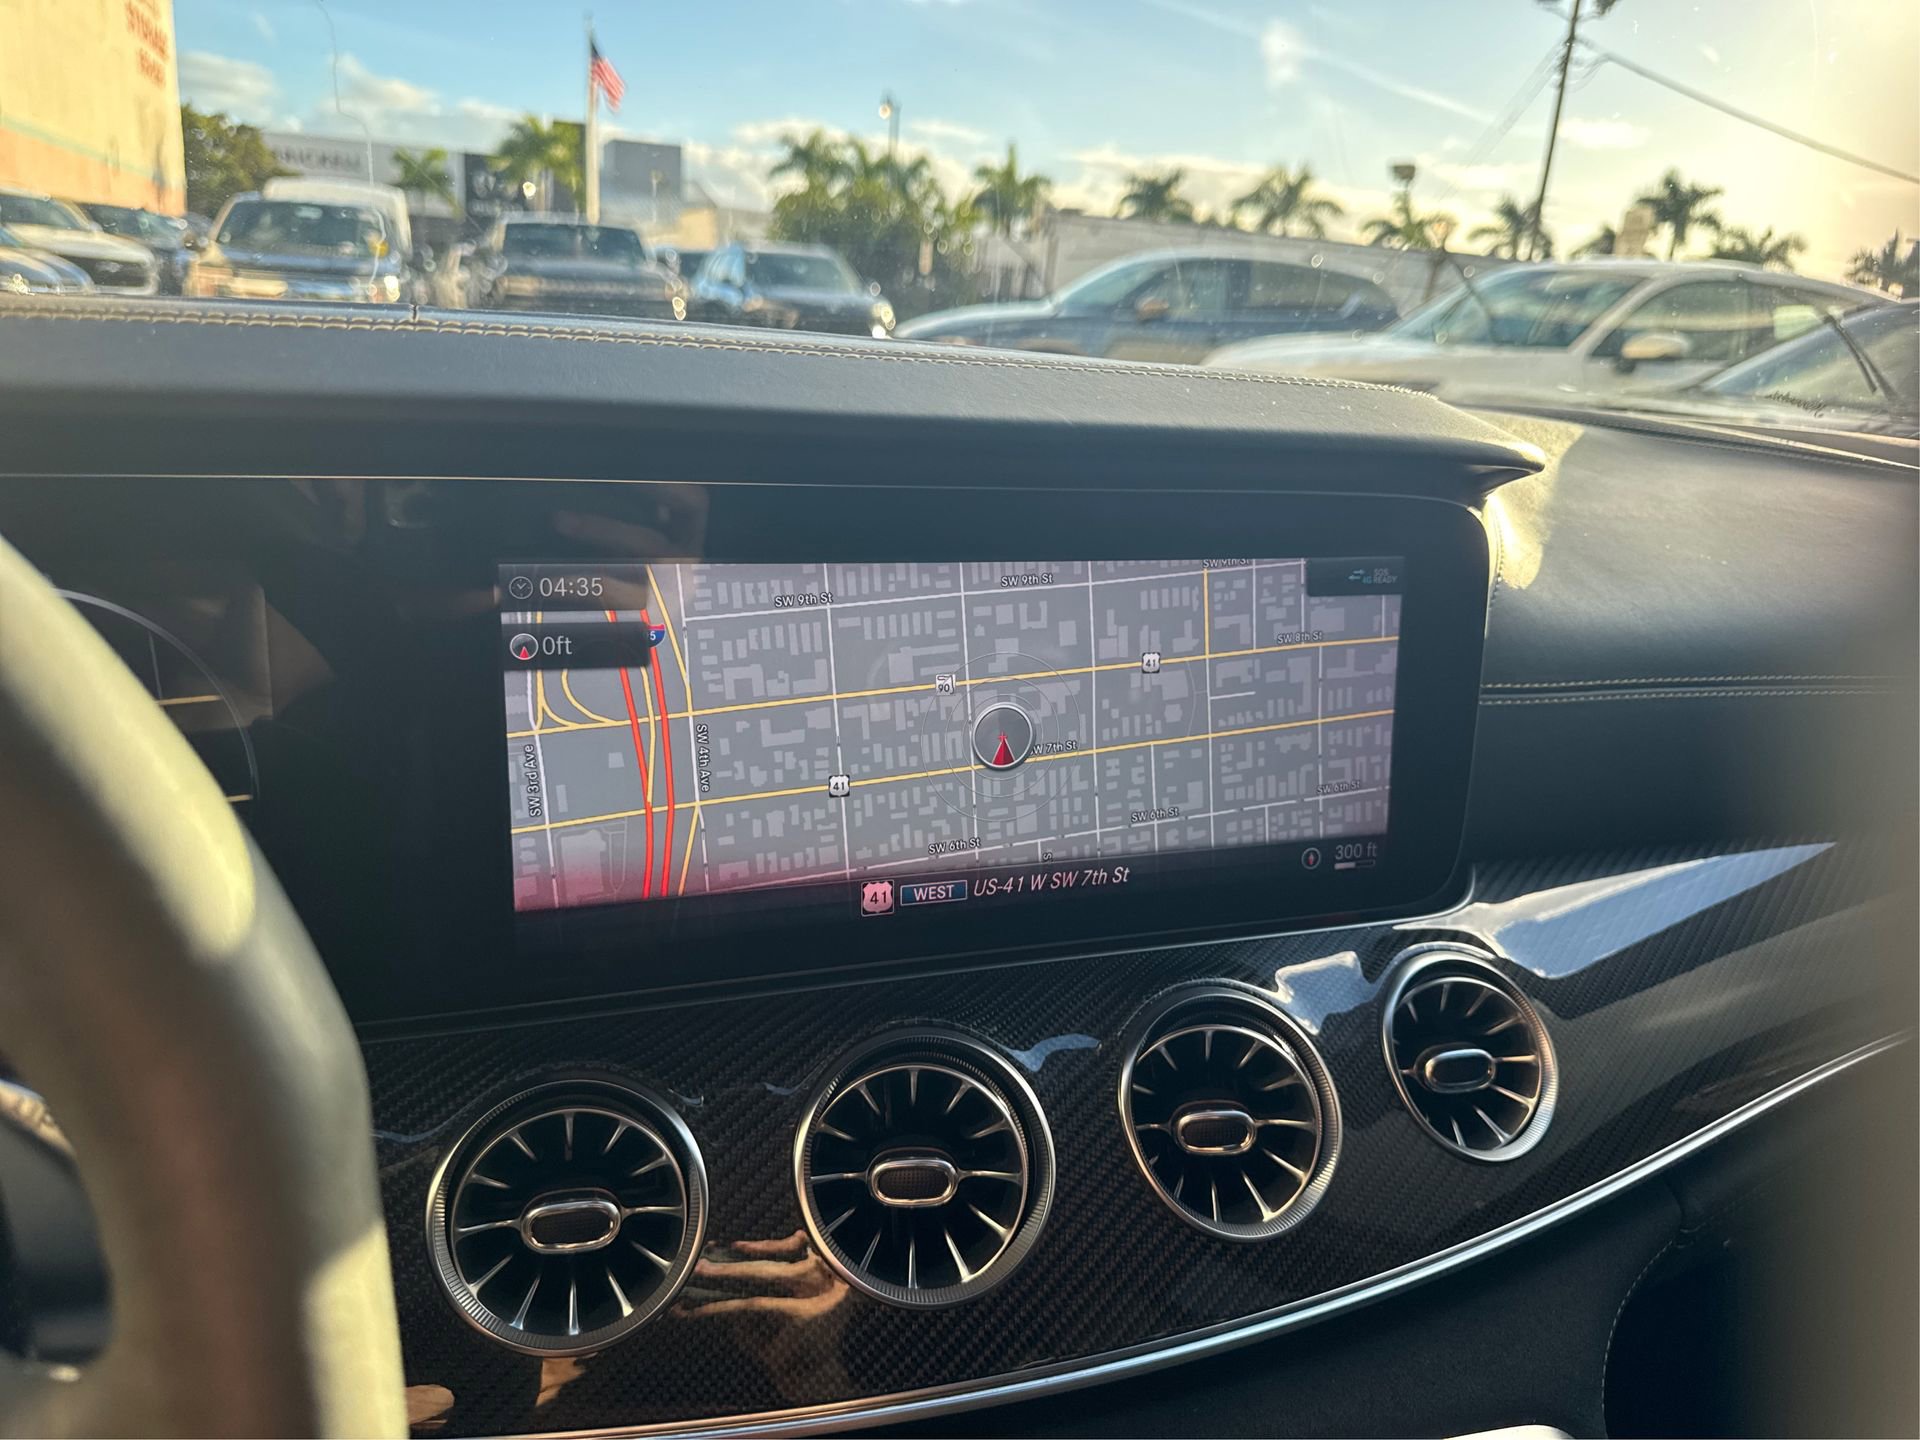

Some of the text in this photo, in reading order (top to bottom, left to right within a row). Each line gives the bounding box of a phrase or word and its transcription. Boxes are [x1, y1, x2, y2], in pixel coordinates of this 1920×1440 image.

[539, 577, 604, 598] 04:35
[1001, 572, 1054, 588] SW 9th St
[1373, 575, 1398, 584] READY
[775, 591, 833, 608] SW 9th St
[541, 635, 573, 656] 0ft
[1277, 630, 1323, 645] SW 8th St
[1144, 658, 1157, 668] 41
[937, 683, 950, 693] 90
[1030, 740, 1078, 756] W 7th St
[697, 723, 711, 792] SW 4th Ave
[524, 745, 543, 817] SW 3rd Ave
[832, 781, 846, 792] 41
[1317, 780, 1361, 794] SW 6th St
[1131, 806, 1179, 823] SW 6th St
[928, 837, 980, 855] SW 6th St
[1335, 841, 1378, 861] 300 ft
[973, 866, 1131, 897] US-41 W SW 7th St
[869, 889, 888, 905] 41
[913, 884, 955, 902] WEST
